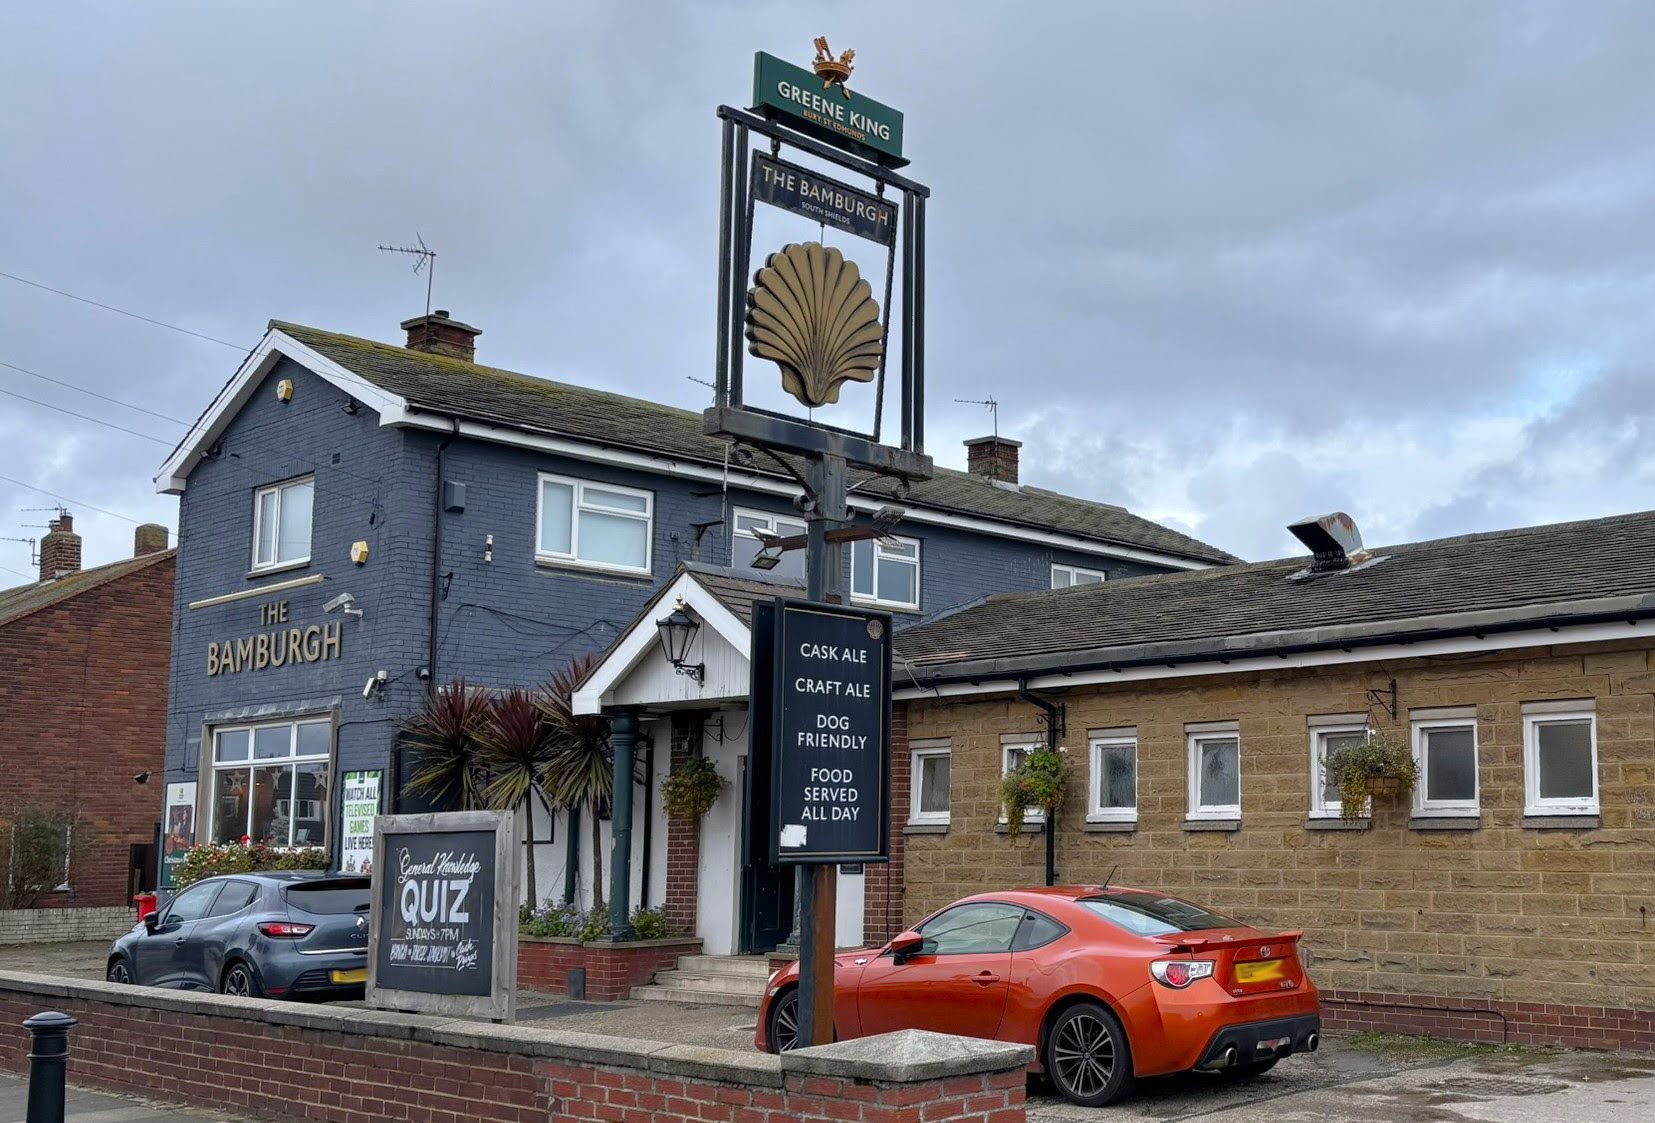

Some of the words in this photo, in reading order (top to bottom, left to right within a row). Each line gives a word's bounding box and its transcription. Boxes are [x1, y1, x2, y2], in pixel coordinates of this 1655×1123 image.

[777, 81, 844, 122] GREENE
[850, 110, 890, 141] KING
[803, 109, 821, 124] BURY
[823, 117, 832, 127] ST
[833, 121, 866, 141] EDMUNDS
[762, 165, 795, 192] THE
[800, 179, 889, 226] BAMBURGH
[801, 201, 824, 216] SOUTH
[824, 208, 850, 225] SHIELDS
[258, 600, 288, 626] THE
[207, 621, 342, 676] BAMBURGH
[800, 643, 839, 661] CASK
[841, 648, 867, 664] ALE
[795, 678, 842, 697] CRAFT
[845, 683, 871, 698] ALE
[816, 714, 850, 730] DOG
[797, 732, 868, 750] FRIENDLY
[811, 768, 853, 783] FOOD
[365, 786, 377, 800] ALL
[804, 787, 858, 802] SERVED
[345, 803, 375, 818] TELEVISED
[801, 806, 827, 821] ALL
[831, 806, 860, 821] DAY
[349, 819, 369, 834] GAMES
[344, 836, 357, 850] LIVE
[398, 847, 436, 884] General
[436, 850, 481, 884] Knowledge
[400, 879, 470, 927] QUIZ
[405, 928, 436, 940] SUNDAYS
[440, 928, 459, 941] 7PM
